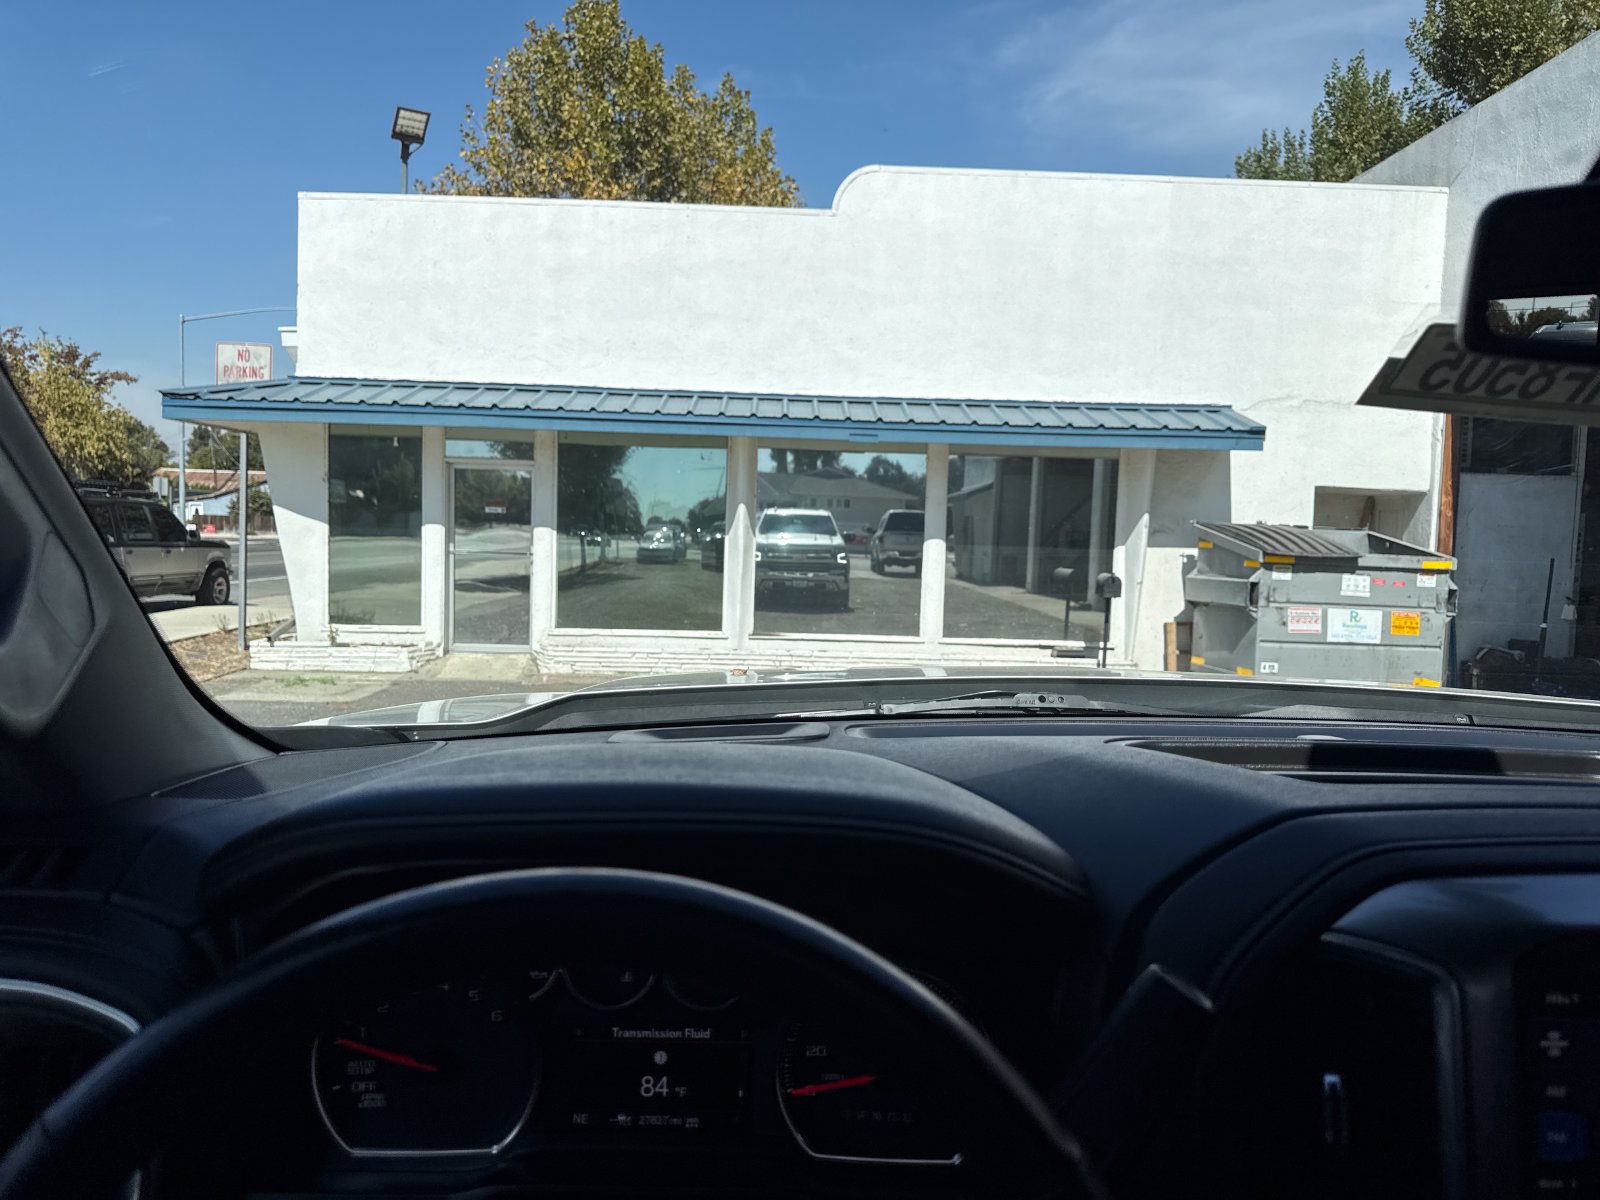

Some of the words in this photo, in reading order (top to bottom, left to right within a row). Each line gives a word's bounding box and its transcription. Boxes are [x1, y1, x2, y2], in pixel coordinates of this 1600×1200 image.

[237, 348, 251, 363] NO
[223, 364, 265, 380] PARKING
[491, 1009, 504, 1022] 6
[611, 1026, 682, 1038] Transmission
[685, 1027, 711, 1039] Fluid
[805, 1045, 828, 1057] 20
[351, 1081, 377, 1092] OFF
[640, 1075, 669, 1097] 84
[572, 1113, 589, 1125] NE
